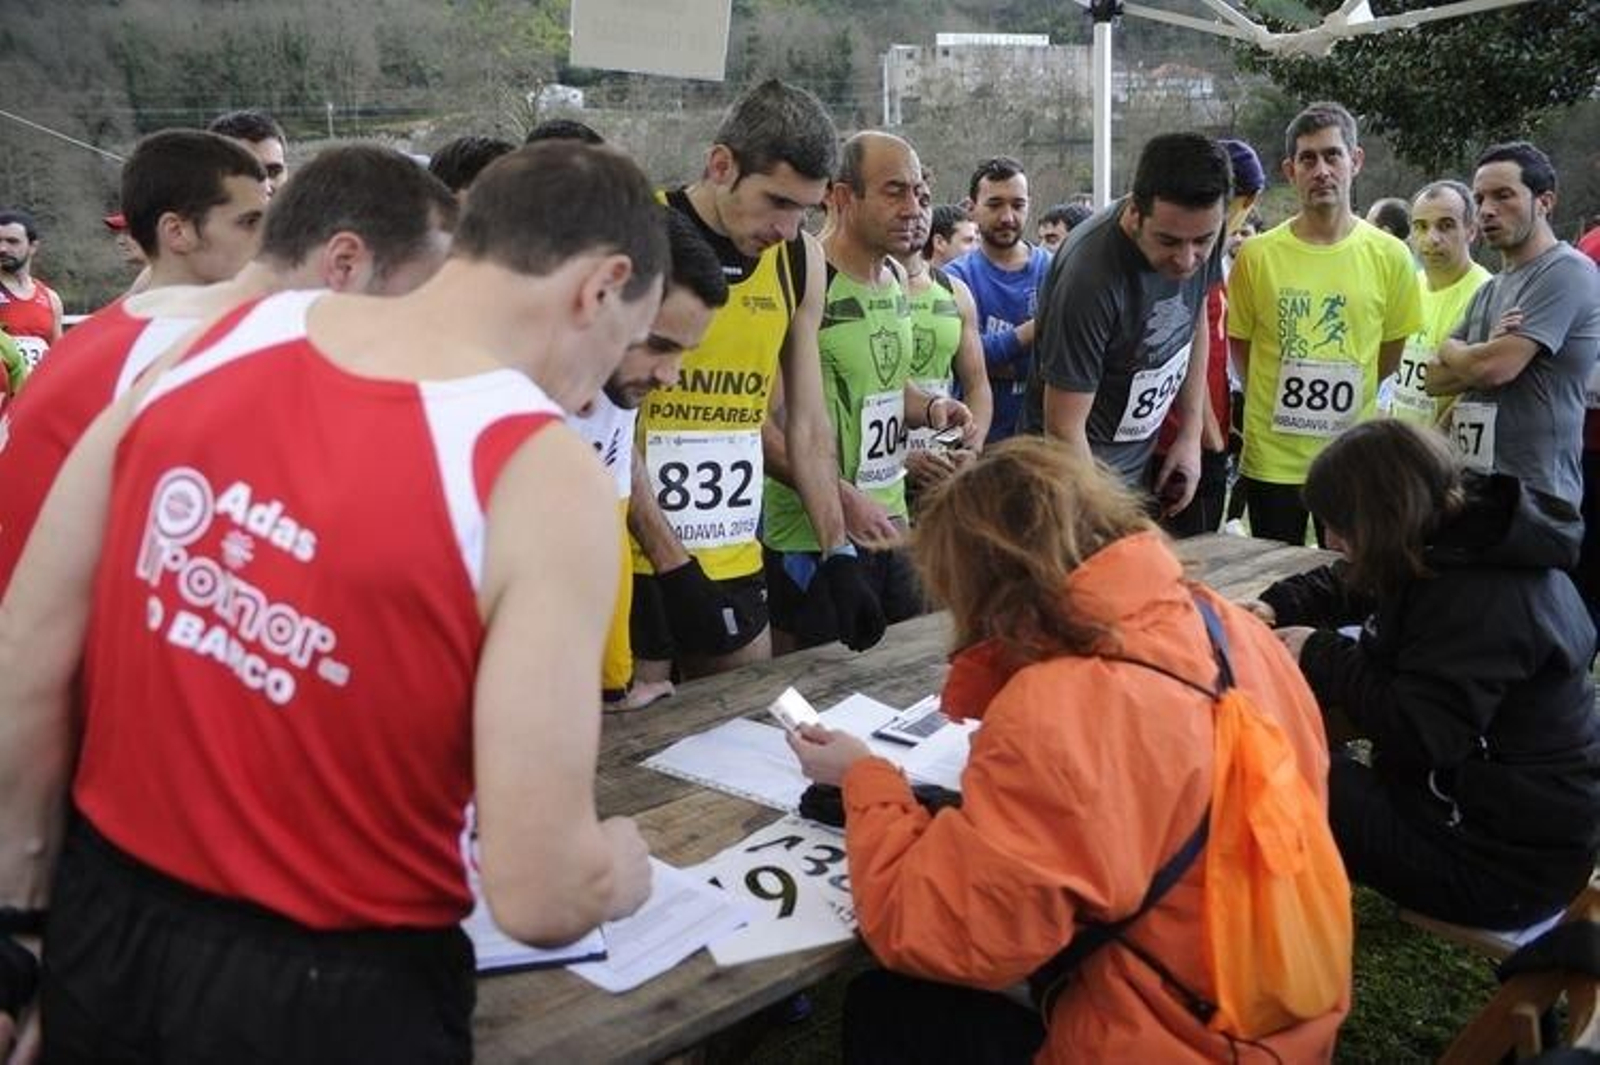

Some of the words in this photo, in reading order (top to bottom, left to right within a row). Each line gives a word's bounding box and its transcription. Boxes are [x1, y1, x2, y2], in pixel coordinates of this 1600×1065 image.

[1278, 298, 1310, 318] SAN
[1281, 376, 1355, 413] 880
[866, 415, 908, 461] 204
[657, 460, 755, 512] 832
[214, 480, 319, 564] Adas
